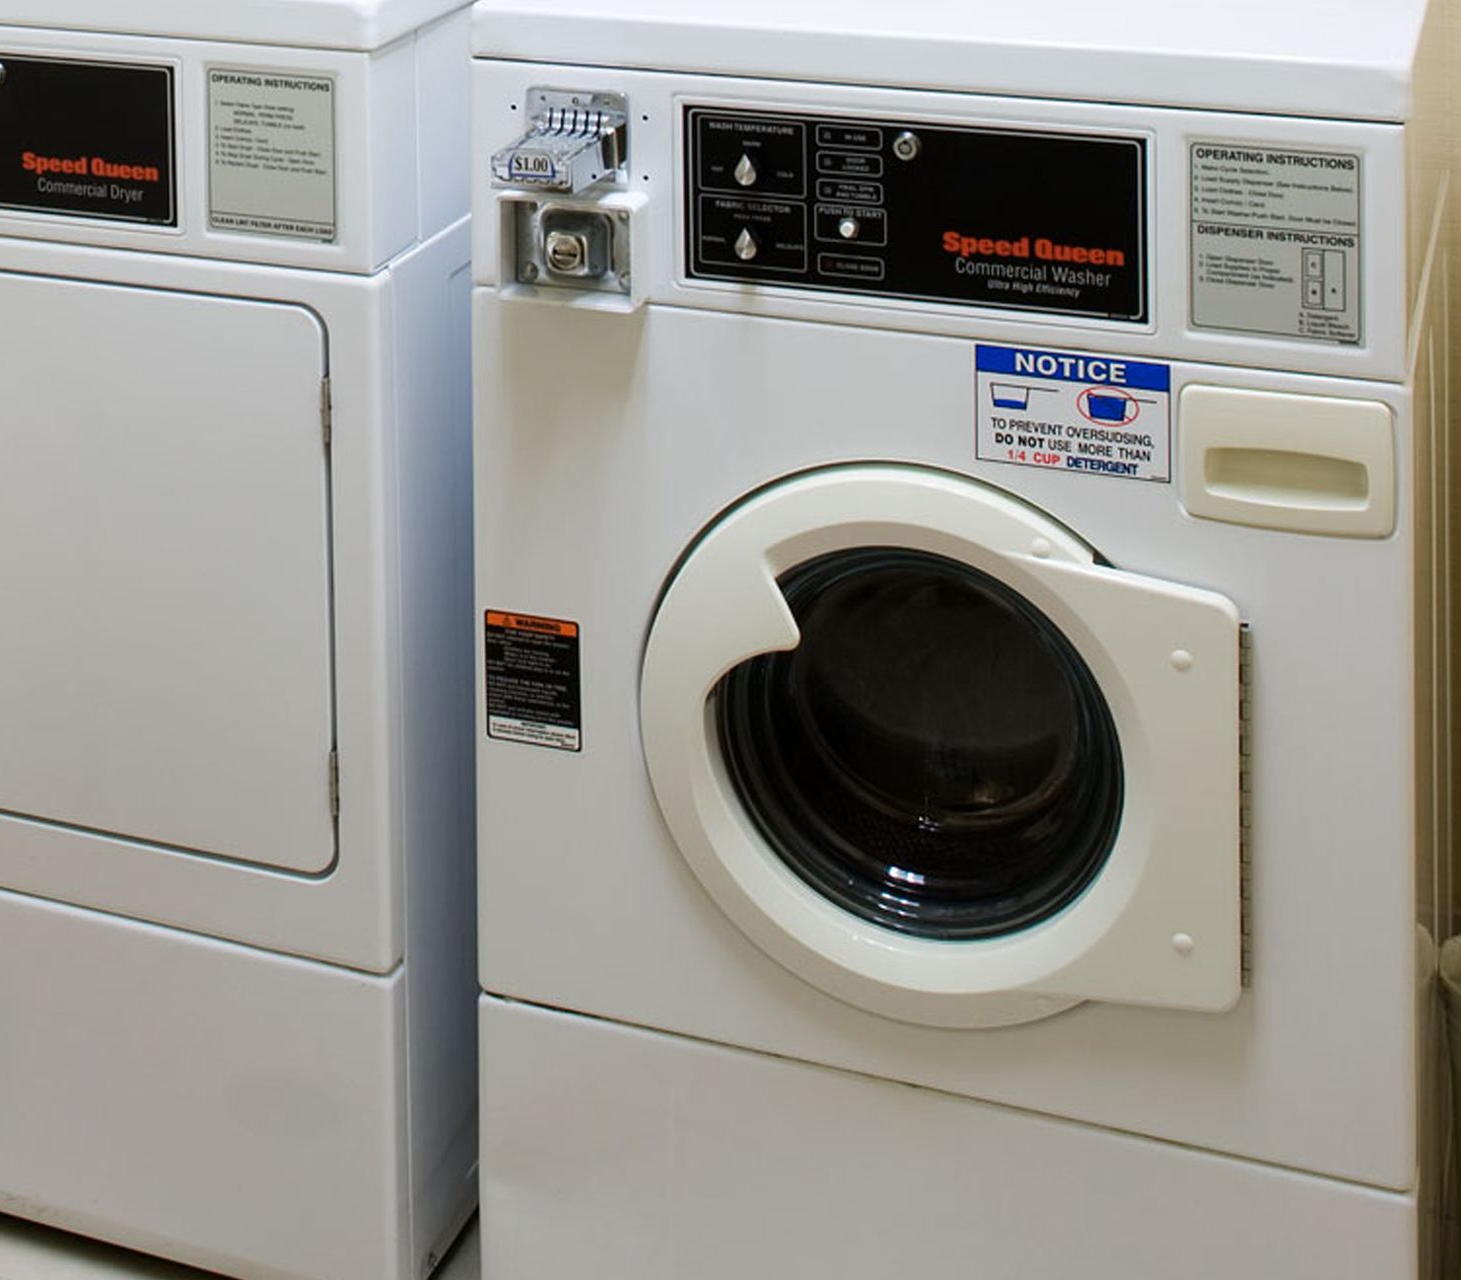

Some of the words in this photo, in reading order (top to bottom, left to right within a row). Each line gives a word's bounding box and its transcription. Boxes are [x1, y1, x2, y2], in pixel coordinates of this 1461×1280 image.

[211, 73, 262, 87] OPERATING
[264, 77, 330, 92] INSTRUCTIONS
[21, 151, 87, 176] Speed
[91, 157, 159, 182] Queen
[513, 154, 548, 172] $1.00
[1196, 147, 1264, 163] OPERATING
[1266, 154, 1355, 171] INSTRUCTIONS
[37, 177, 108, 198] Commercial
[110, 183, 144, 203] Dryer
[942, 230, 1030, 257] Speed
[1034, 238, 1125, 266] Queen
[1197, 224, 1264, 240] DISPENSER
[1266, 230, 1355, 247] INSTRUCTIONS
[955, 257, 1047, 281] Commercial
[1050, 265, 1112, 287] Washer
[1012, 281, 1034, 294] High
[1014, 352, 1127, 384] NOTICE
[990, 417, 1007, 430] TO
[1008, 419, 1064, 437] PREVENT
[995, 432, 1014, 445] DO
[1017, 435, 1045, 449] NOT
[1048, 439, 1072, 452] USE
[1078, 442, 1113, 457] MORE
[1118, 446, 1152, 462] THAN
[1007, 449, 1026, 462] 1/4
[1033, 452, 1061, 465] CUP
[1066, 455, 1140, 476] DETERGENT
